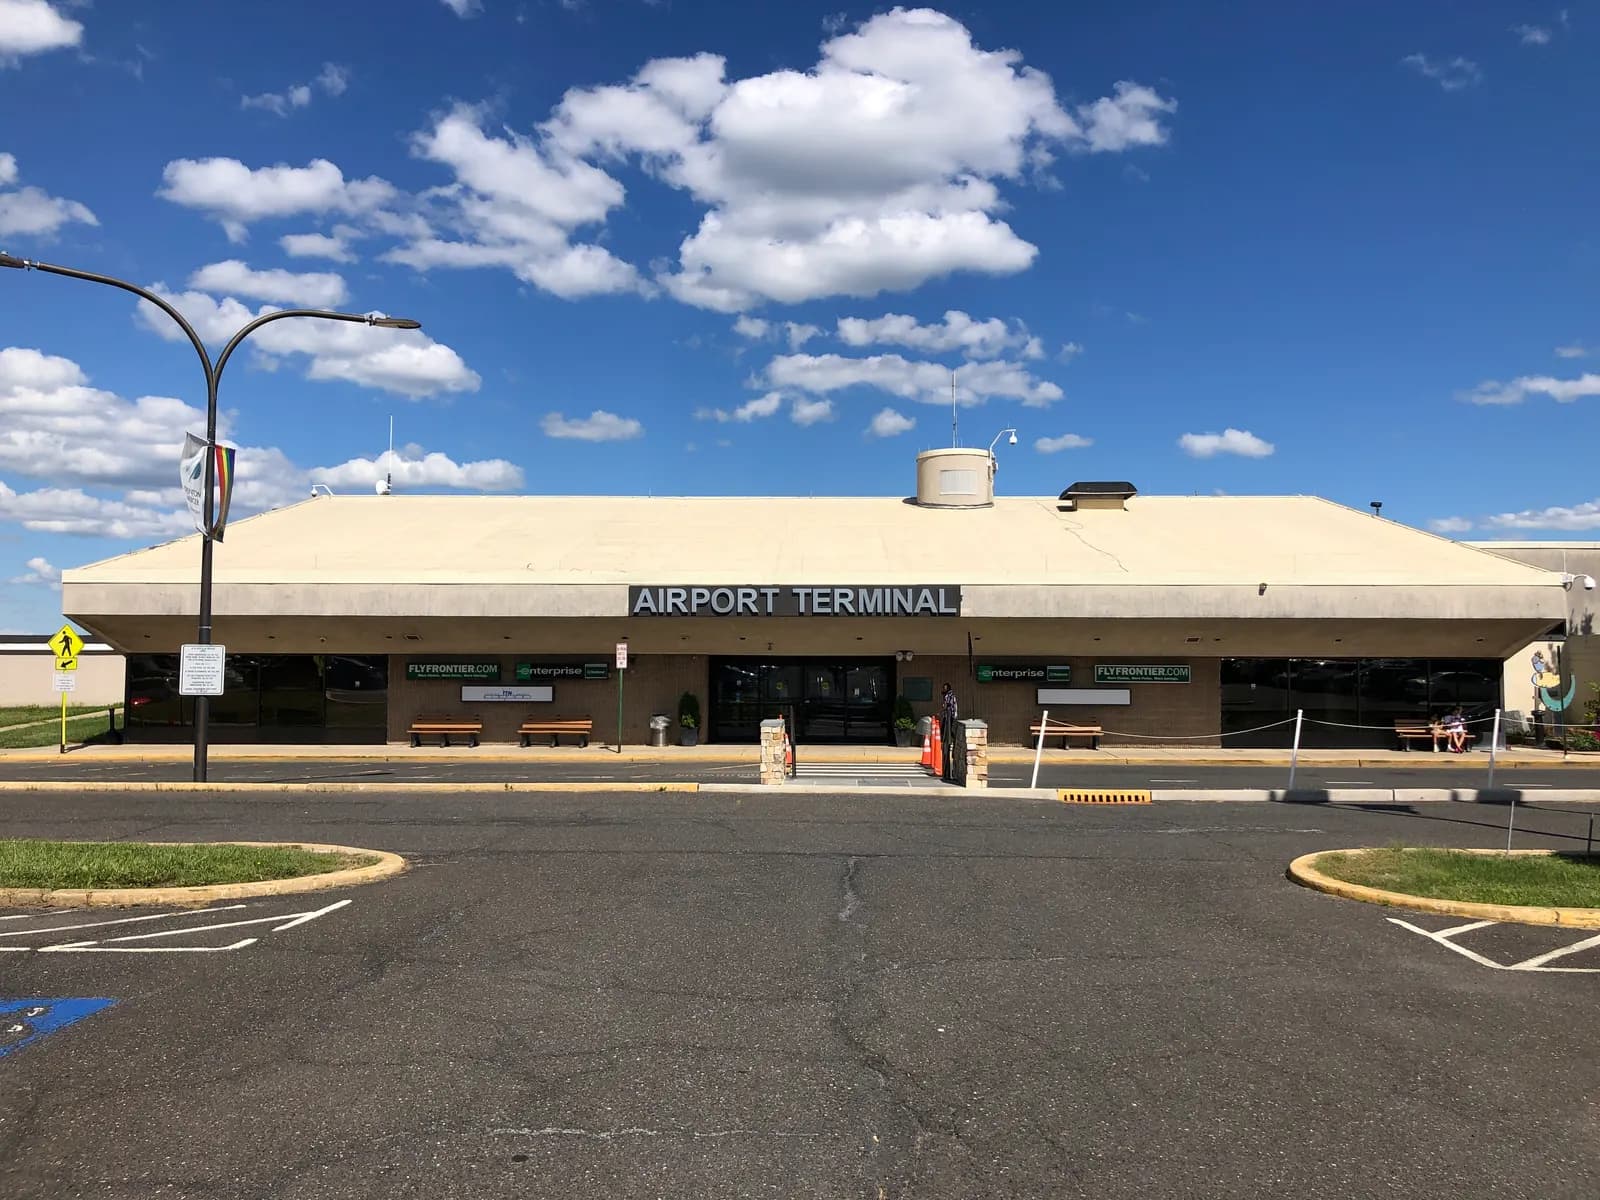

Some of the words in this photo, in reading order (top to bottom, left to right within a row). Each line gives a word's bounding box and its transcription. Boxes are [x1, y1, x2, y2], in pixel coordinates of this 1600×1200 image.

[632, 587, 781, 614] AIRPORT
[791, 587, 959, 614] TERMINAL
[408, 664, 498, 673] FLYFRONTIER.COM
[517, 666, 583, 677] enterprise
[979, 668, 1045, 679] enterprise
[1097, 667, 1189, 676] FLYFRONTIER.COM
